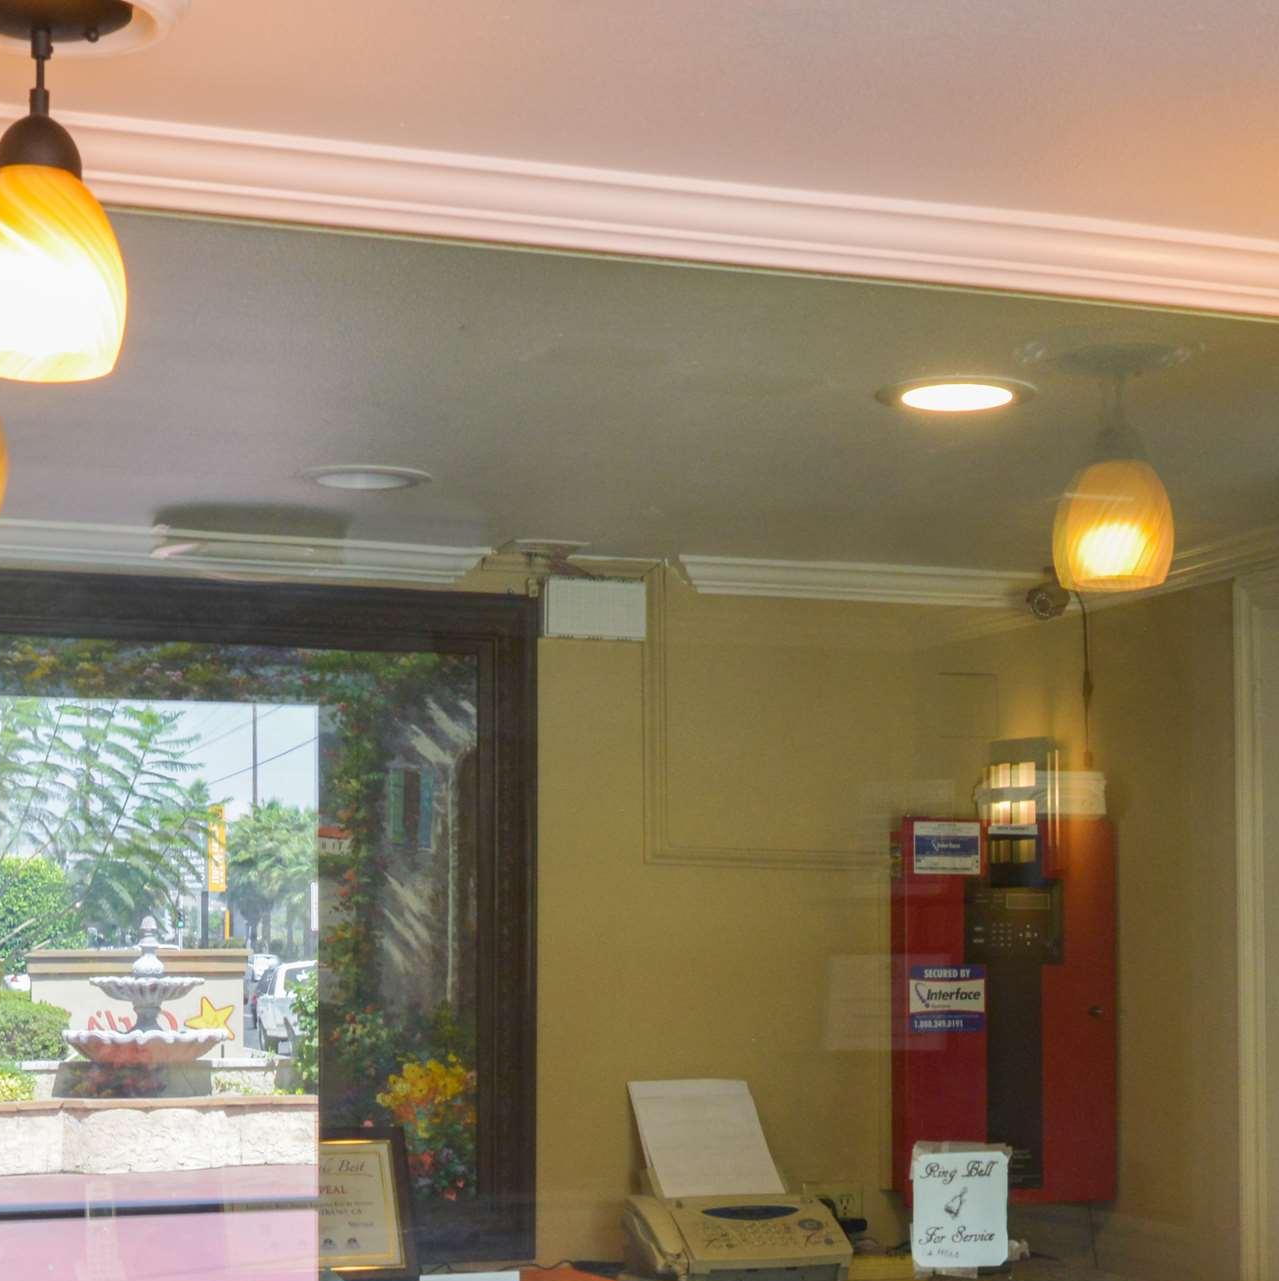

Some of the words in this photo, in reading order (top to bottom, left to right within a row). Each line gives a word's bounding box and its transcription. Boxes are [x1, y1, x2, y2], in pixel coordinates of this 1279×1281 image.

[923, 968, 959, 978] SECURED
[960, 968, 971, 977] BY
[927, 987, 982, 1001] Interface
[920, 1162, 958, 1185] Ring
[961, 1160, 999, 1178] Bell
[919, 1226, 946, 1245] For
[951, 1225, 996, 1244] Service
